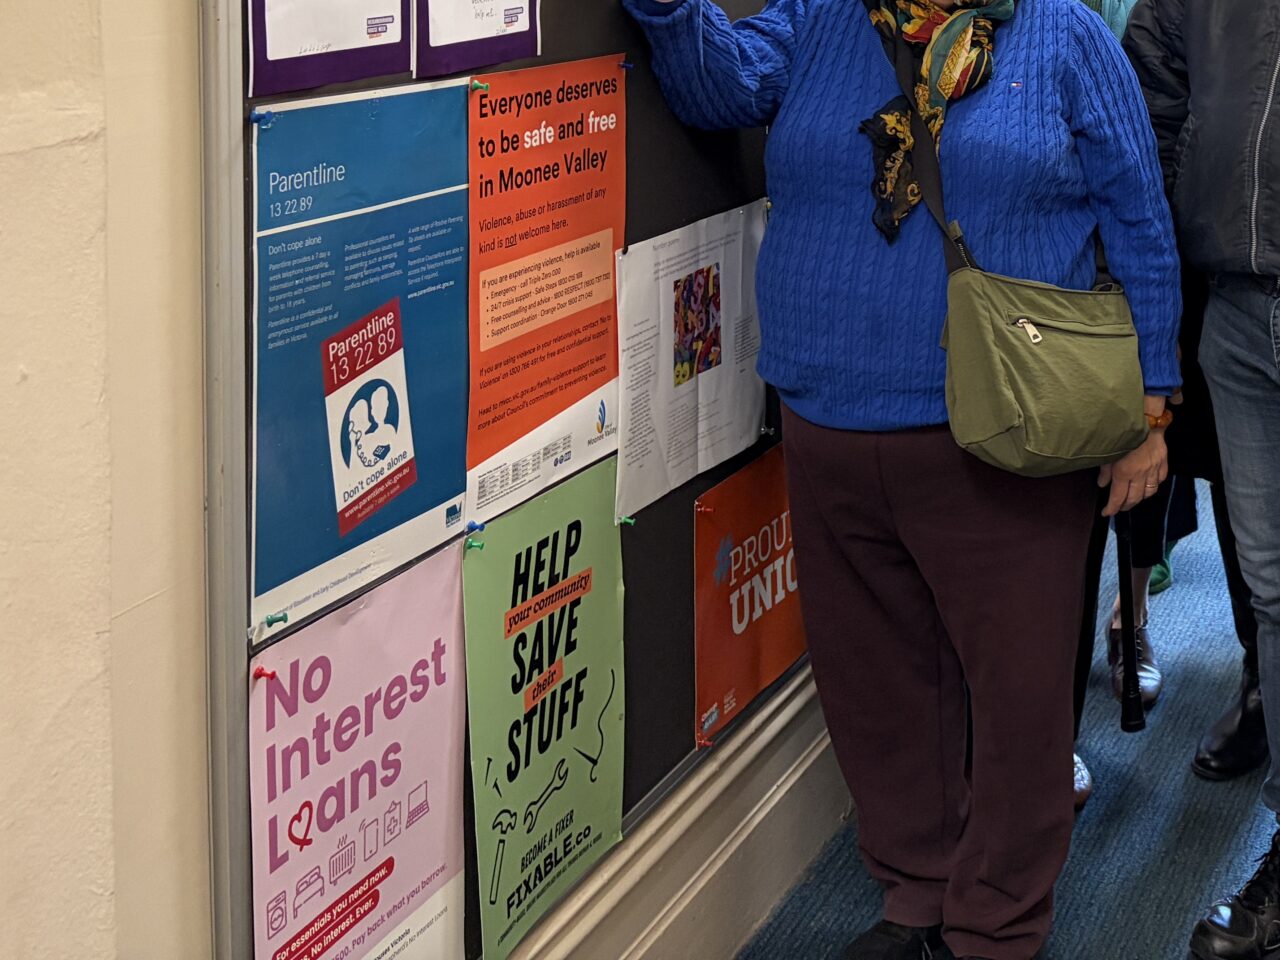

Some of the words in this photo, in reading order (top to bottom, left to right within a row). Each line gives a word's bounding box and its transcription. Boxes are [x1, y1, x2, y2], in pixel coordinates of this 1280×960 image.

[479, 89, 551, 119] Everyone
[556, 77, 617, 104] deserves
[479, 137, 495, 158] to
[501, 130, 519, 154] be
[523, 120, 554, 148] safe
[558, 113, 584, 140] and
[588, 110, 616, 134] free
[269, 162, 346, 195] Parentline
[479, 173, 494, 199] in
[499, 161, 560, 193] Moonee
[563, 146, 608, 175] Valley
[270, 203, 282, 218] 13
[284, 199, 300, 217] 22
[299, 196, 313, 212] 89
[479, 212, 514, 233] Violence,
[515, 206, 536, 222] abuse
[537, 205, 545, 215] or
[547, 192, 585, 212] harassment
[586, 190, 593, 201] of
[594, 187, 606, 200] any
[268, 242, 286, 256] Don't
[287, 240, 304, 253] cope
[304, 235, 322, 248] alone
[479, 238, 496, 255] kind
[497, 237, 503, 248] is
[504, 233, 518, 248] not
[518, 223, 550, 241] welcome
[551, 217, 569, 235] here.
[482, 280, 487, 289] If
[487, 277, 498, 289] you
[499, 274, 508, 283] are
[508, 262, 542, 280] experiencing
[542, 255, 564, 268] violence,
[564, 251, 575, 261] help
[580, 241, 601, 254] available
[490, 285, 517, 300] Emergency
[520, 280, 529, 289] call
[529, 274, 541, 286] Triple
[490, 315, 502, 324] Free
[502, 305, 528, 321] counselling
[528, 301, 537, 311] and
[537, 296, 551, 307] advice
[491, 325, 510, 338] Support
[510, 313, 538, 330] coordination
[329, 312, 394, 362] Parentline
[331, 357, 349, 384] 13
[354, 341, 374, 370] 22
[378, 328, 395, 355] 89
[587, 433, 604, 446] Moonee
[605, 427, 617, 440] Valley
[343, 481, 365, 502] Don't
[366, 467, 385, 486] cope
[387, 450, 407, 471] alone
[511, 519, 582, 608] HELP
[713, 510, 791, 587] #PROU
[507, 604, 532, 633] your
[533, 572, 590, 615] community
[730, 548, 798, 635] UNIO
[511, 595, 582, 695] SAVE
[265, 655, 332, 732] No
[531, 668, 557, 701] their
[266, 637, 447, 804] Interest
[507, 666, 588, 784] STUFF
[521, 838, 548, 873] BECOME
[554, 809, 574, 838] FIXER
[507, 825, 592, 919] FIXABLE.co
[275, 945, 290, 960] For
[290, 911, 332, 951] essentials
[332, 899, 348, 919] you
[348, 880, 369, 906] need
[369, 867, 388, 887] now.
[311, 942, 323, 956] No
[323, 914, 355, 945] interest.
[355, 898, 375, 919] Ever.
[352, 933, 366, 951] Pay
[366, 915, 386, 937] back
[386, 898, 406, 919] what
[406, 886, 421, 902] you
[421, 862, 448, 889] borrow.
